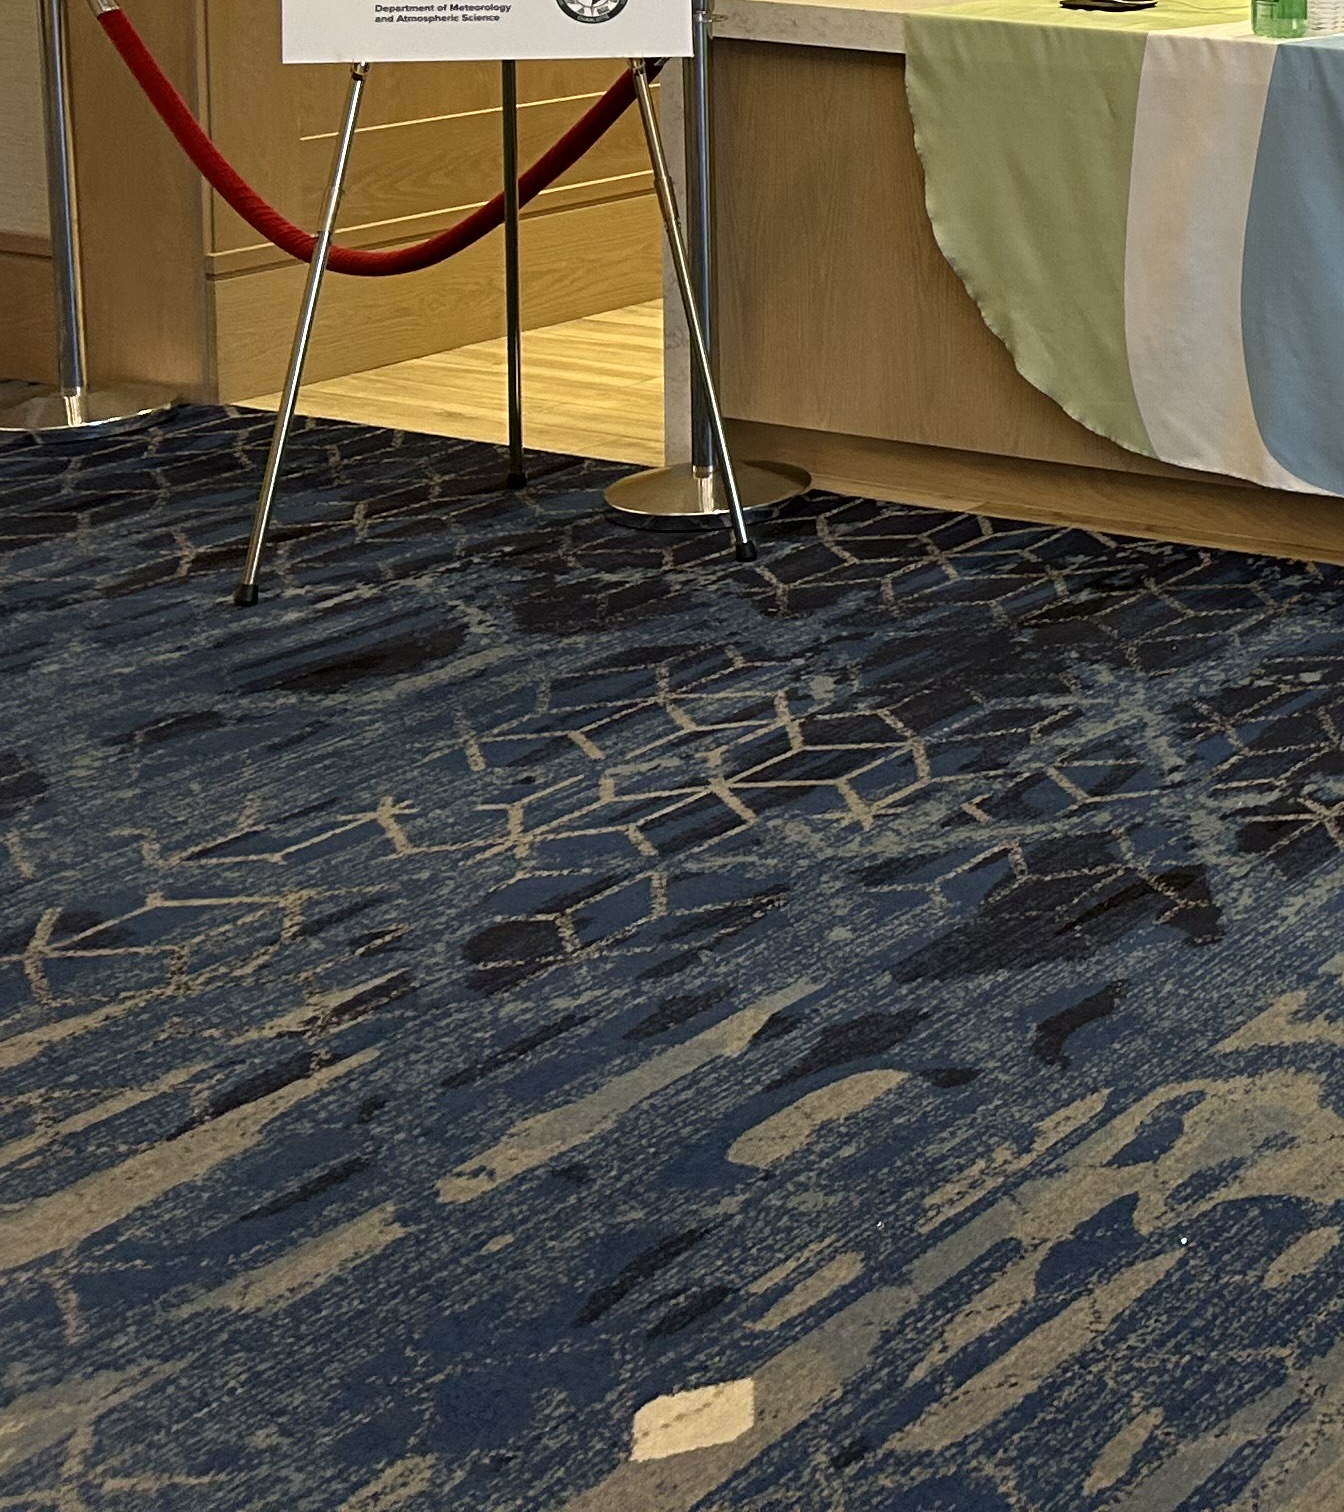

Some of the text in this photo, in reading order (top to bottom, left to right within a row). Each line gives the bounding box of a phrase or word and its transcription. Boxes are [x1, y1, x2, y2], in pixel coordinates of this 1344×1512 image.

[375, 4, 434, 13] Department
[449, 4, 512, 13] Meteorology
[375, 14, 500, 24] and Atmospheric Science
